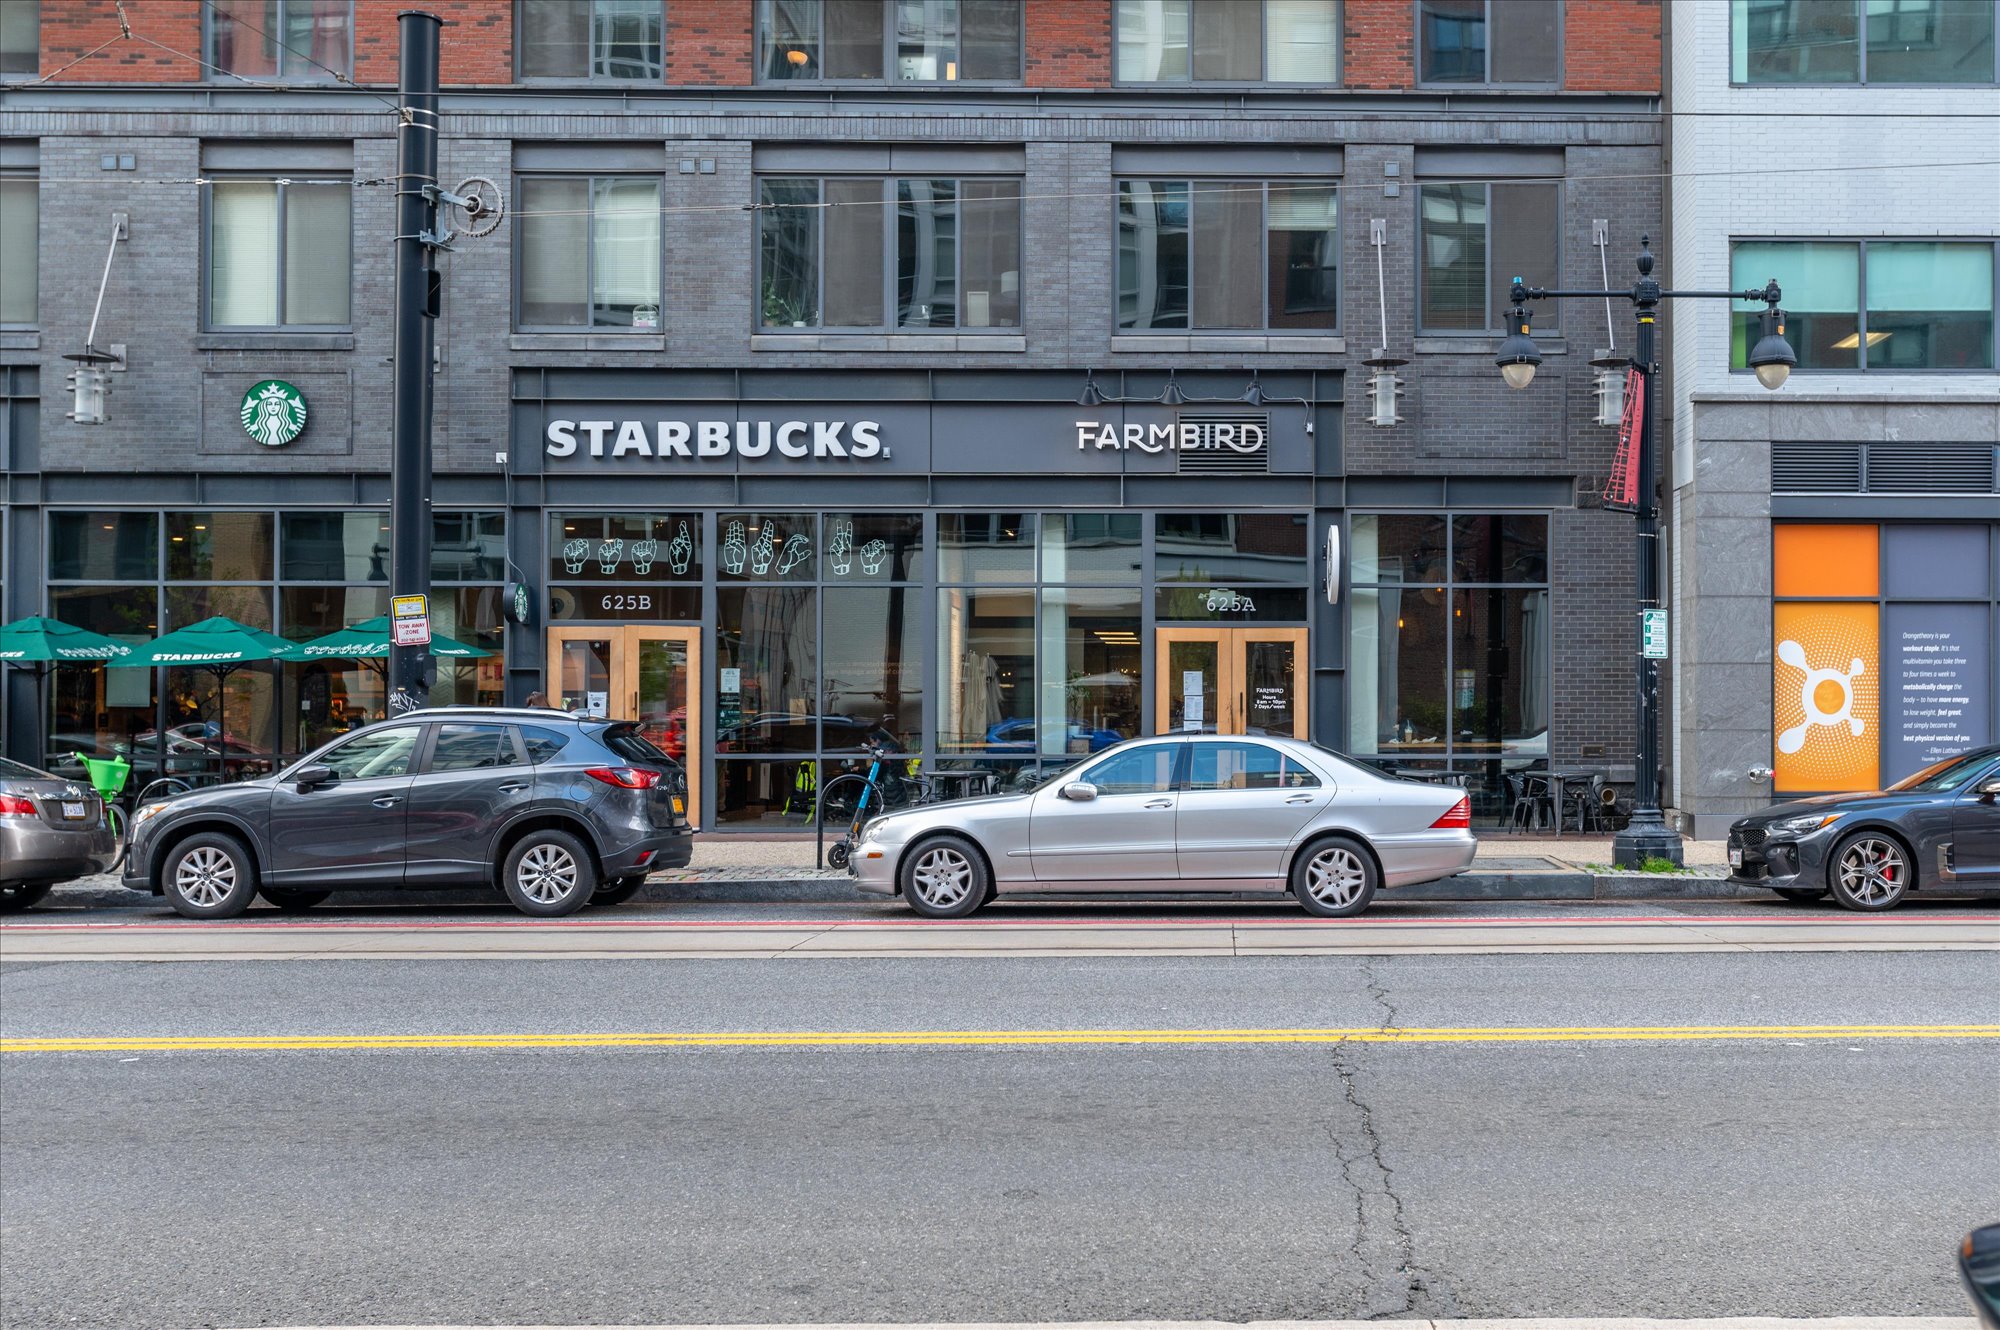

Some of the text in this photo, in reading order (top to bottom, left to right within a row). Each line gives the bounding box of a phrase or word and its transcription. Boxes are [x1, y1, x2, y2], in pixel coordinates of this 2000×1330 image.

[547, 420, 881, 458] STARBUCKS
[1076, 422, 1264, 453] FARMBIRD
[602, 594, 652, 610] 625B
[1206, 596, 1256, 612] 625A
[1903, 632, 1934, 640] Orangetheory
[152, 651, 242, 661] STARBUCKS
